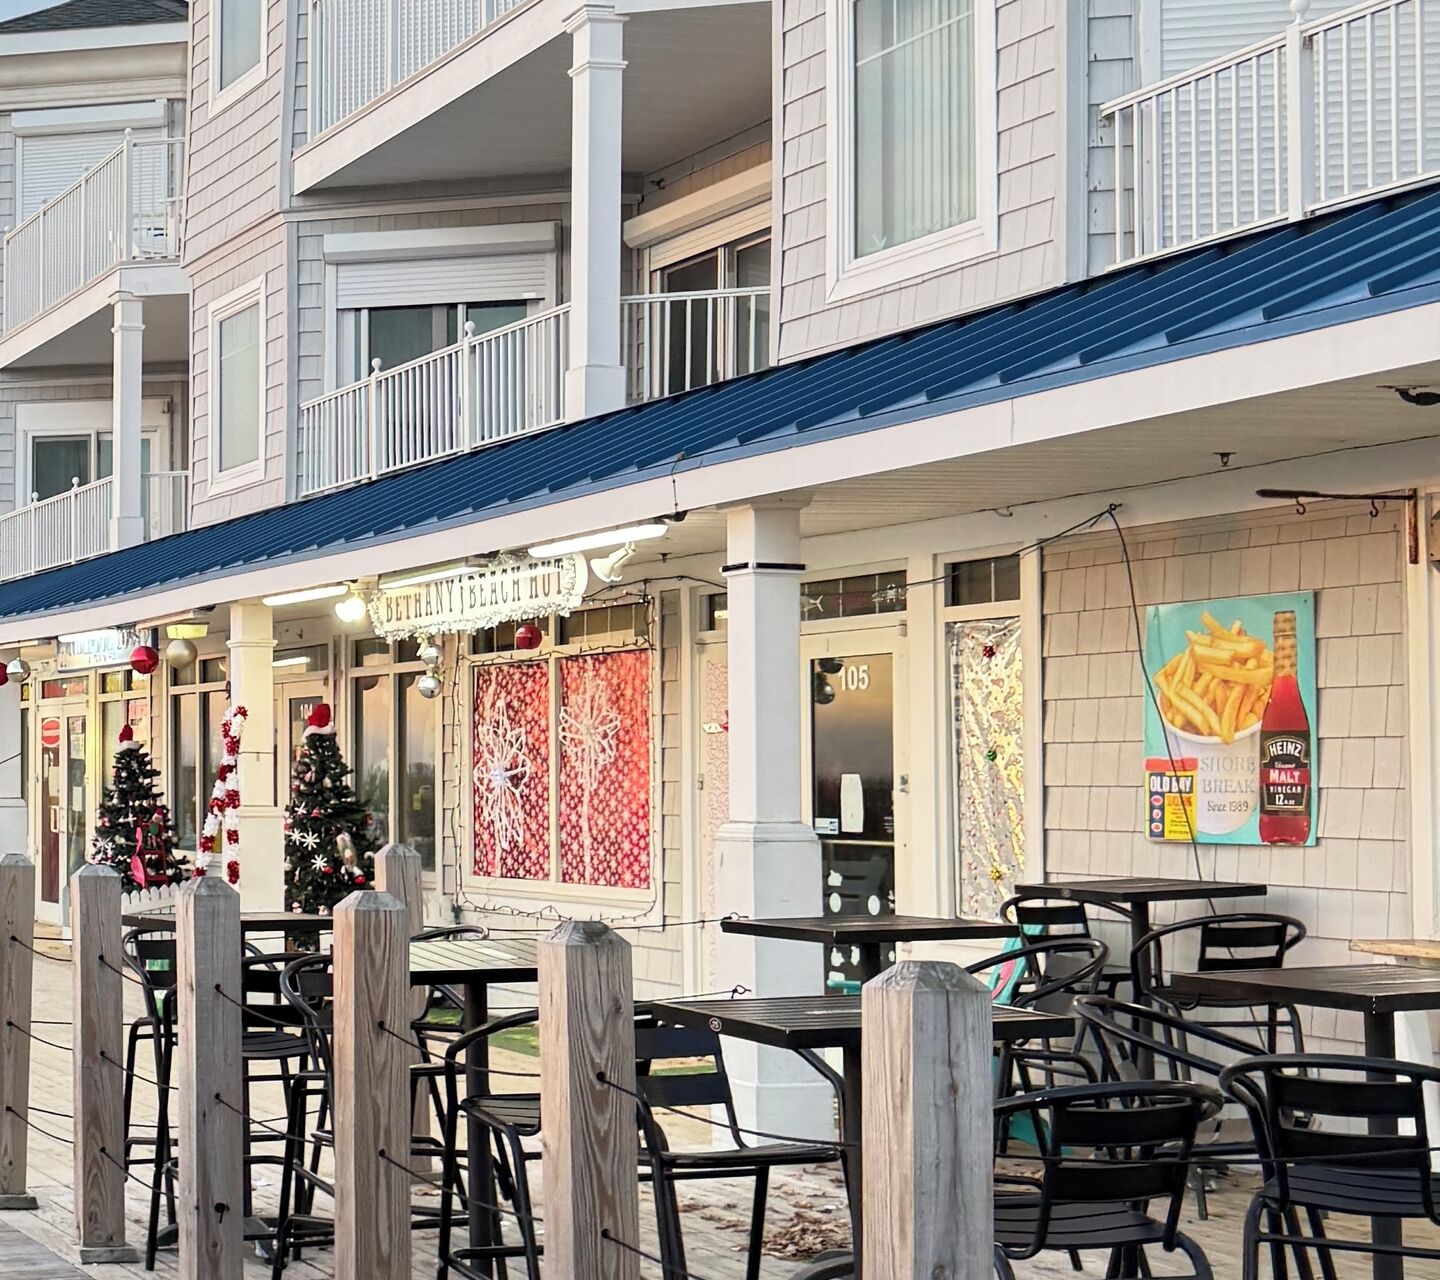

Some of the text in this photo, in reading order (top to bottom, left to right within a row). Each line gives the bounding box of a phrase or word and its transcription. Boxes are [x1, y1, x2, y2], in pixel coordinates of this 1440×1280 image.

[385, 558, 565, 624] BETHANY BEACH HUT
[838, 665, 870, 692] 105
[1269, 740, 1303, 757] HEINZ
[1200, 756, 1255, 772] SHORE
[1150, 775, 1170, 792] OLD
[1269, 769, 1301, 784] MALT
[1202, 778, 1256, 794] BREAK
[1275, 793, 1285, 806] 12
